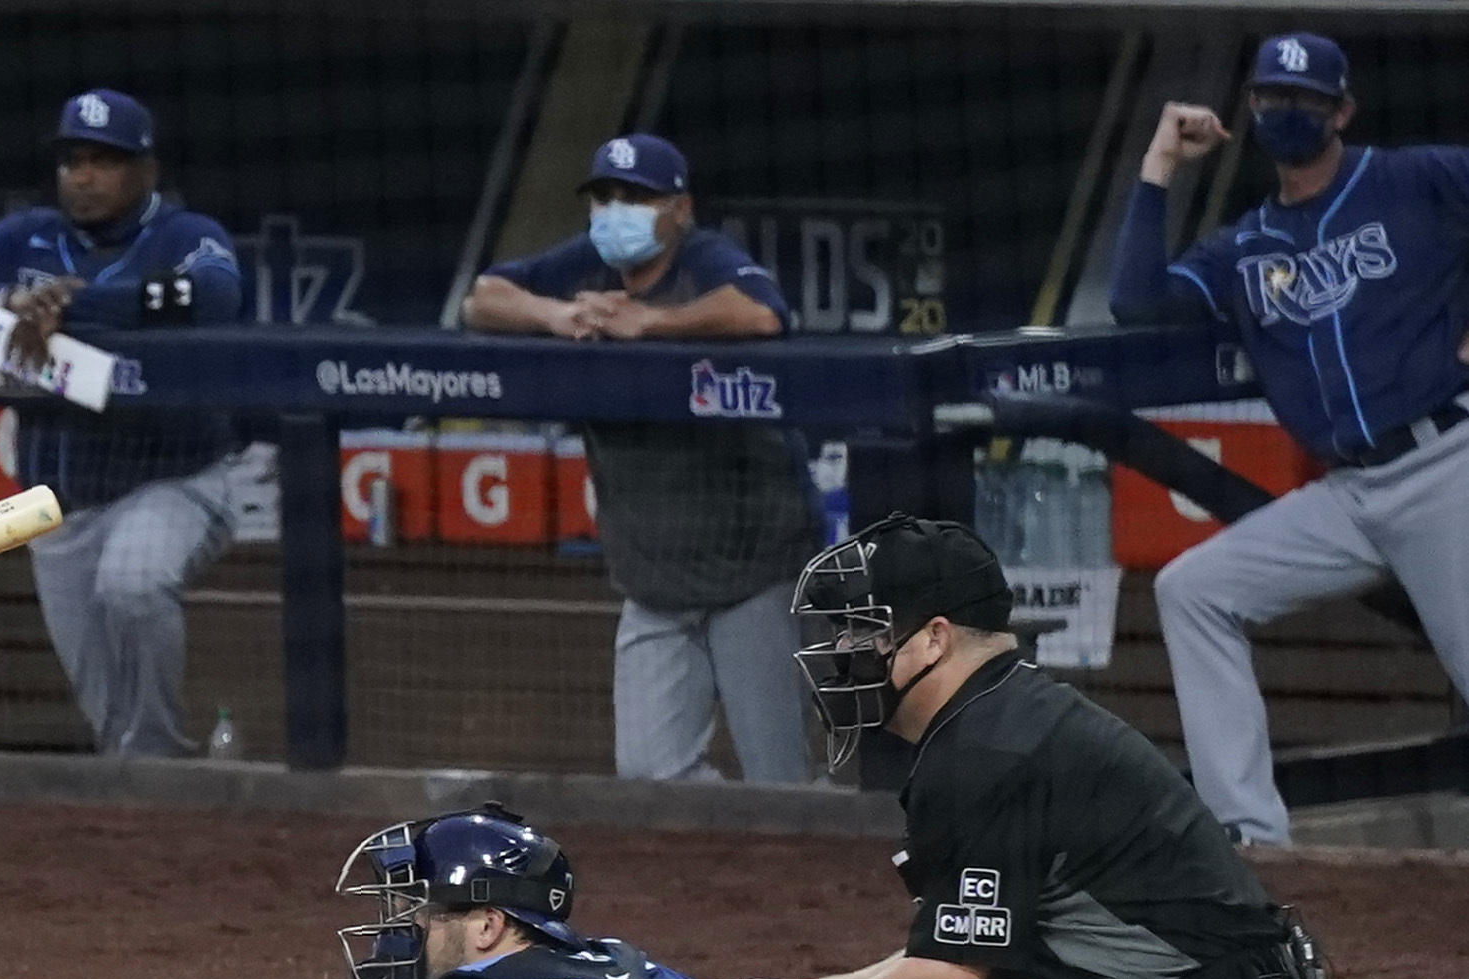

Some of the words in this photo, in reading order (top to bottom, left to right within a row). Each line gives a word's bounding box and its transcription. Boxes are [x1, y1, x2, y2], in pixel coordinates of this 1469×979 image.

[316, 360, 502, 403] @LasMayores
[1018, 361, 1071, 393] MLB
[462, 455, 510, 527] G
[963, 877, 995, 898] EC
[939, 914, 971, 935] CM
[975, 916, 1006, 937] RR
